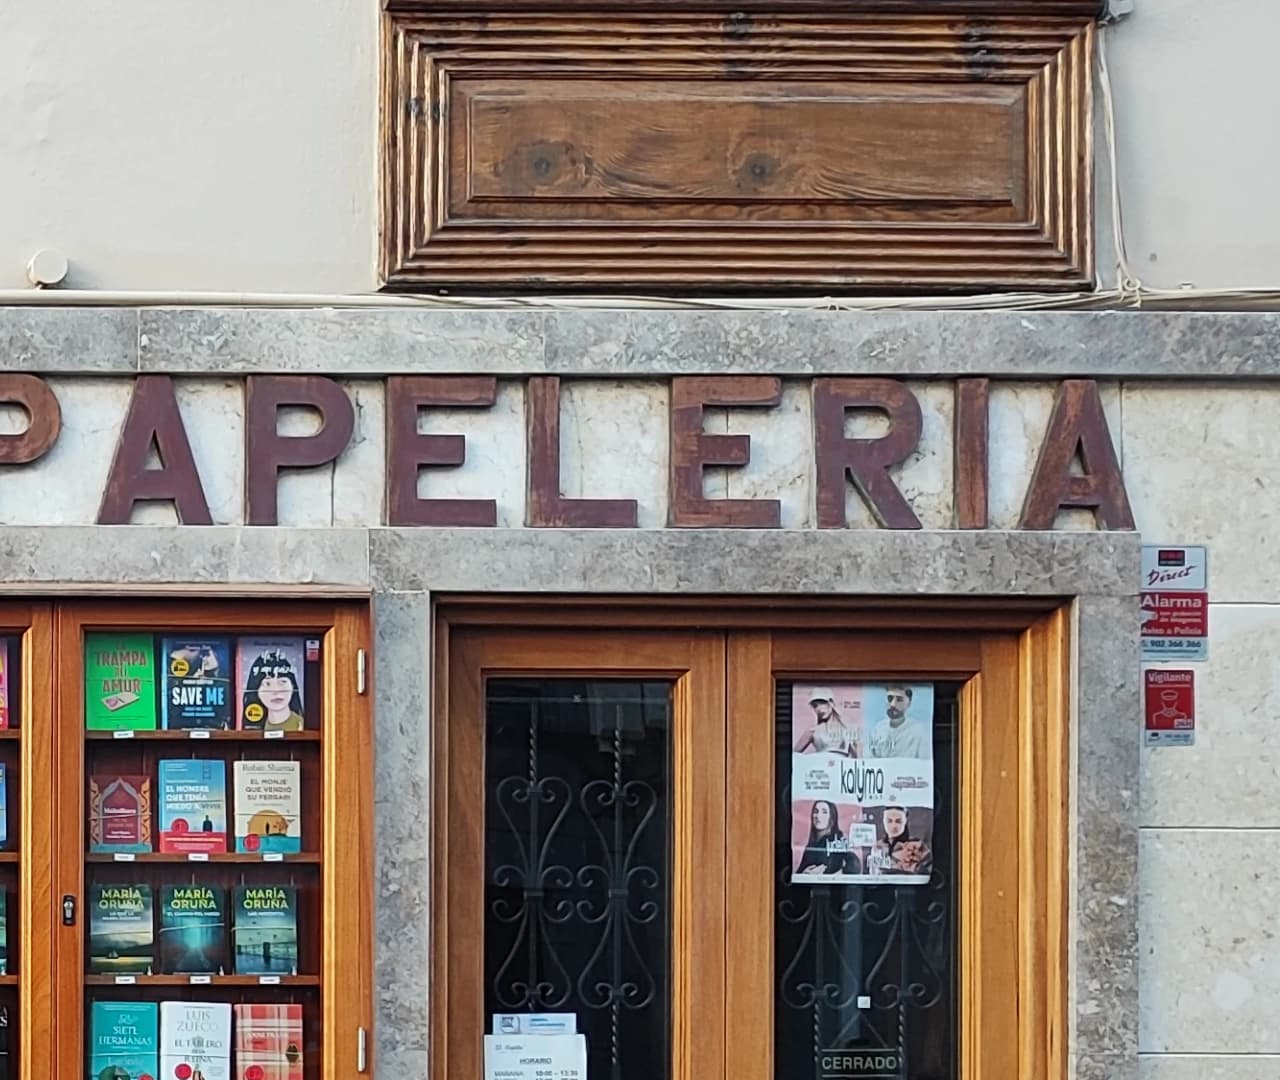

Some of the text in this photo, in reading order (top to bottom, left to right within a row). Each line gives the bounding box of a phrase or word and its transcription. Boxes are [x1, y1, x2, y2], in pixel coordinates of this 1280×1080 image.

[1147, 565, 1198, 586] Direct
[1142, 595, 1202, 608] Alarma
[1150, 639, 1201, 648] 902 366 366
[96, 652, 146, 666] TRAMPA
[1148, 672, 1191, 683] Vigilante
[172, 687, 224, 705] SAVE ME
[840, 759, 884, 802] kalyma
[101, 887, 142, 899] MARÍA
[173, 887, 214, 899] MARÍA
[245, 887, 287, 899] MARÍA
[99, 899, 144, 909] ORUÑA
[171, 899, 217, 909] ORUÑA
[243, 899, 289, 909] ORUÑA
[822, 1056, 897, 1069] CERRADO
